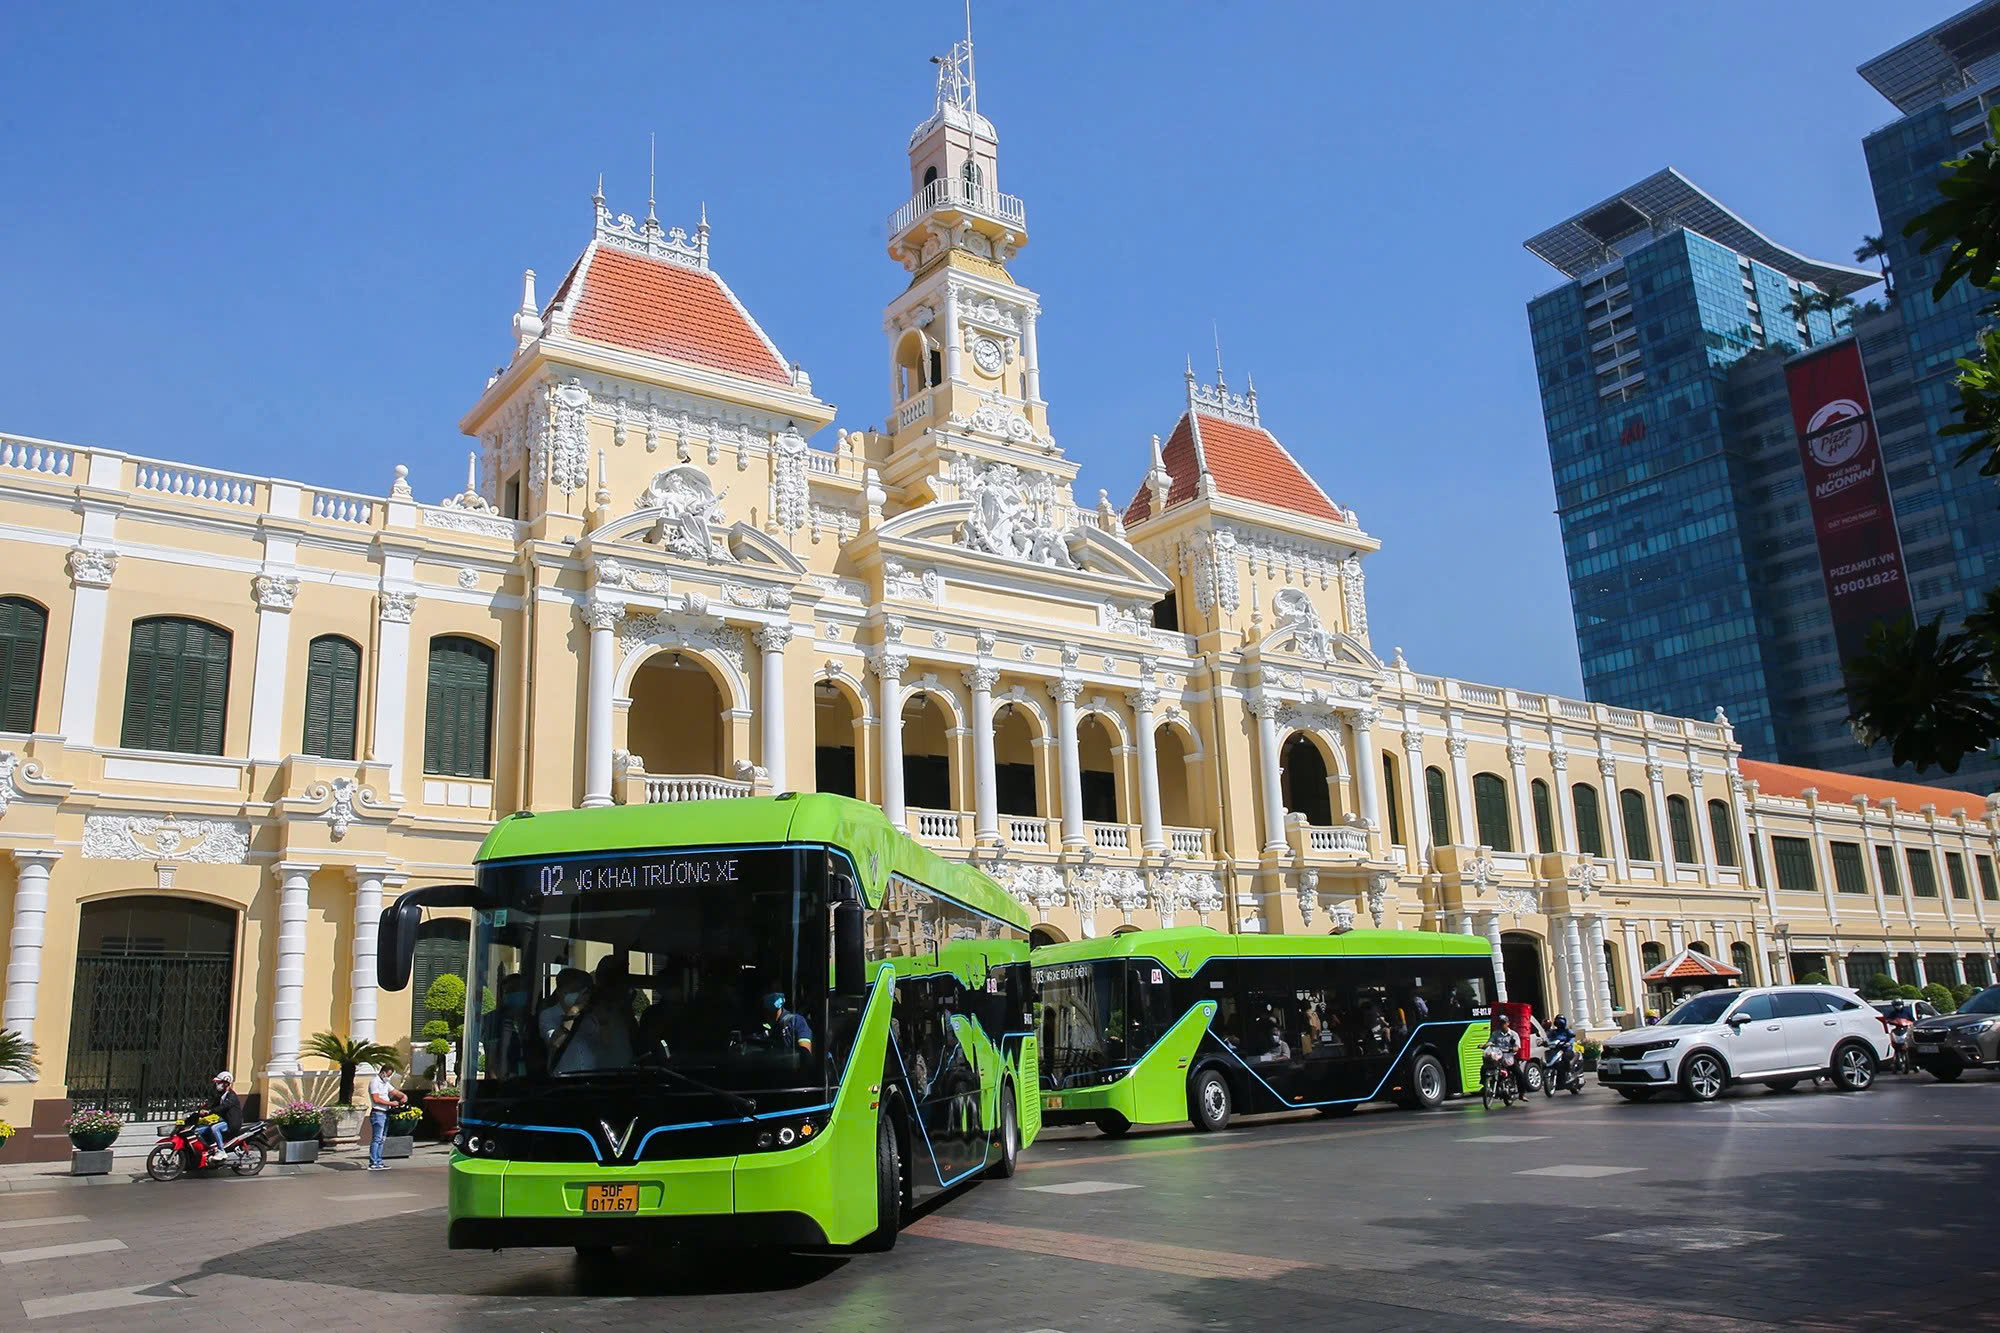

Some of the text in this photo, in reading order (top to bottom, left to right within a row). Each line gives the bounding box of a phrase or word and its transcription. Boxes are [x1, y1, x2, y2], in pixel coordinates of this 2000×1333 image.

[1821, 429, 1853, 452] Pizza
[1828, 436, 1851, 456] Hut
[1815, 458, 1876, 497] NGONNN!
[1829, 552, 1894, 578] PIZZAHUT.VN
[1833, 569, 1899, 597] 19001822
[540, 865, 563, 896] 02
[598, 866, 636, 888] KHAI
[716, 860, 739, 882] XE
[601, 1184, 624, 1197] 50F
[591, 1198, 633, 1211] 017.67
